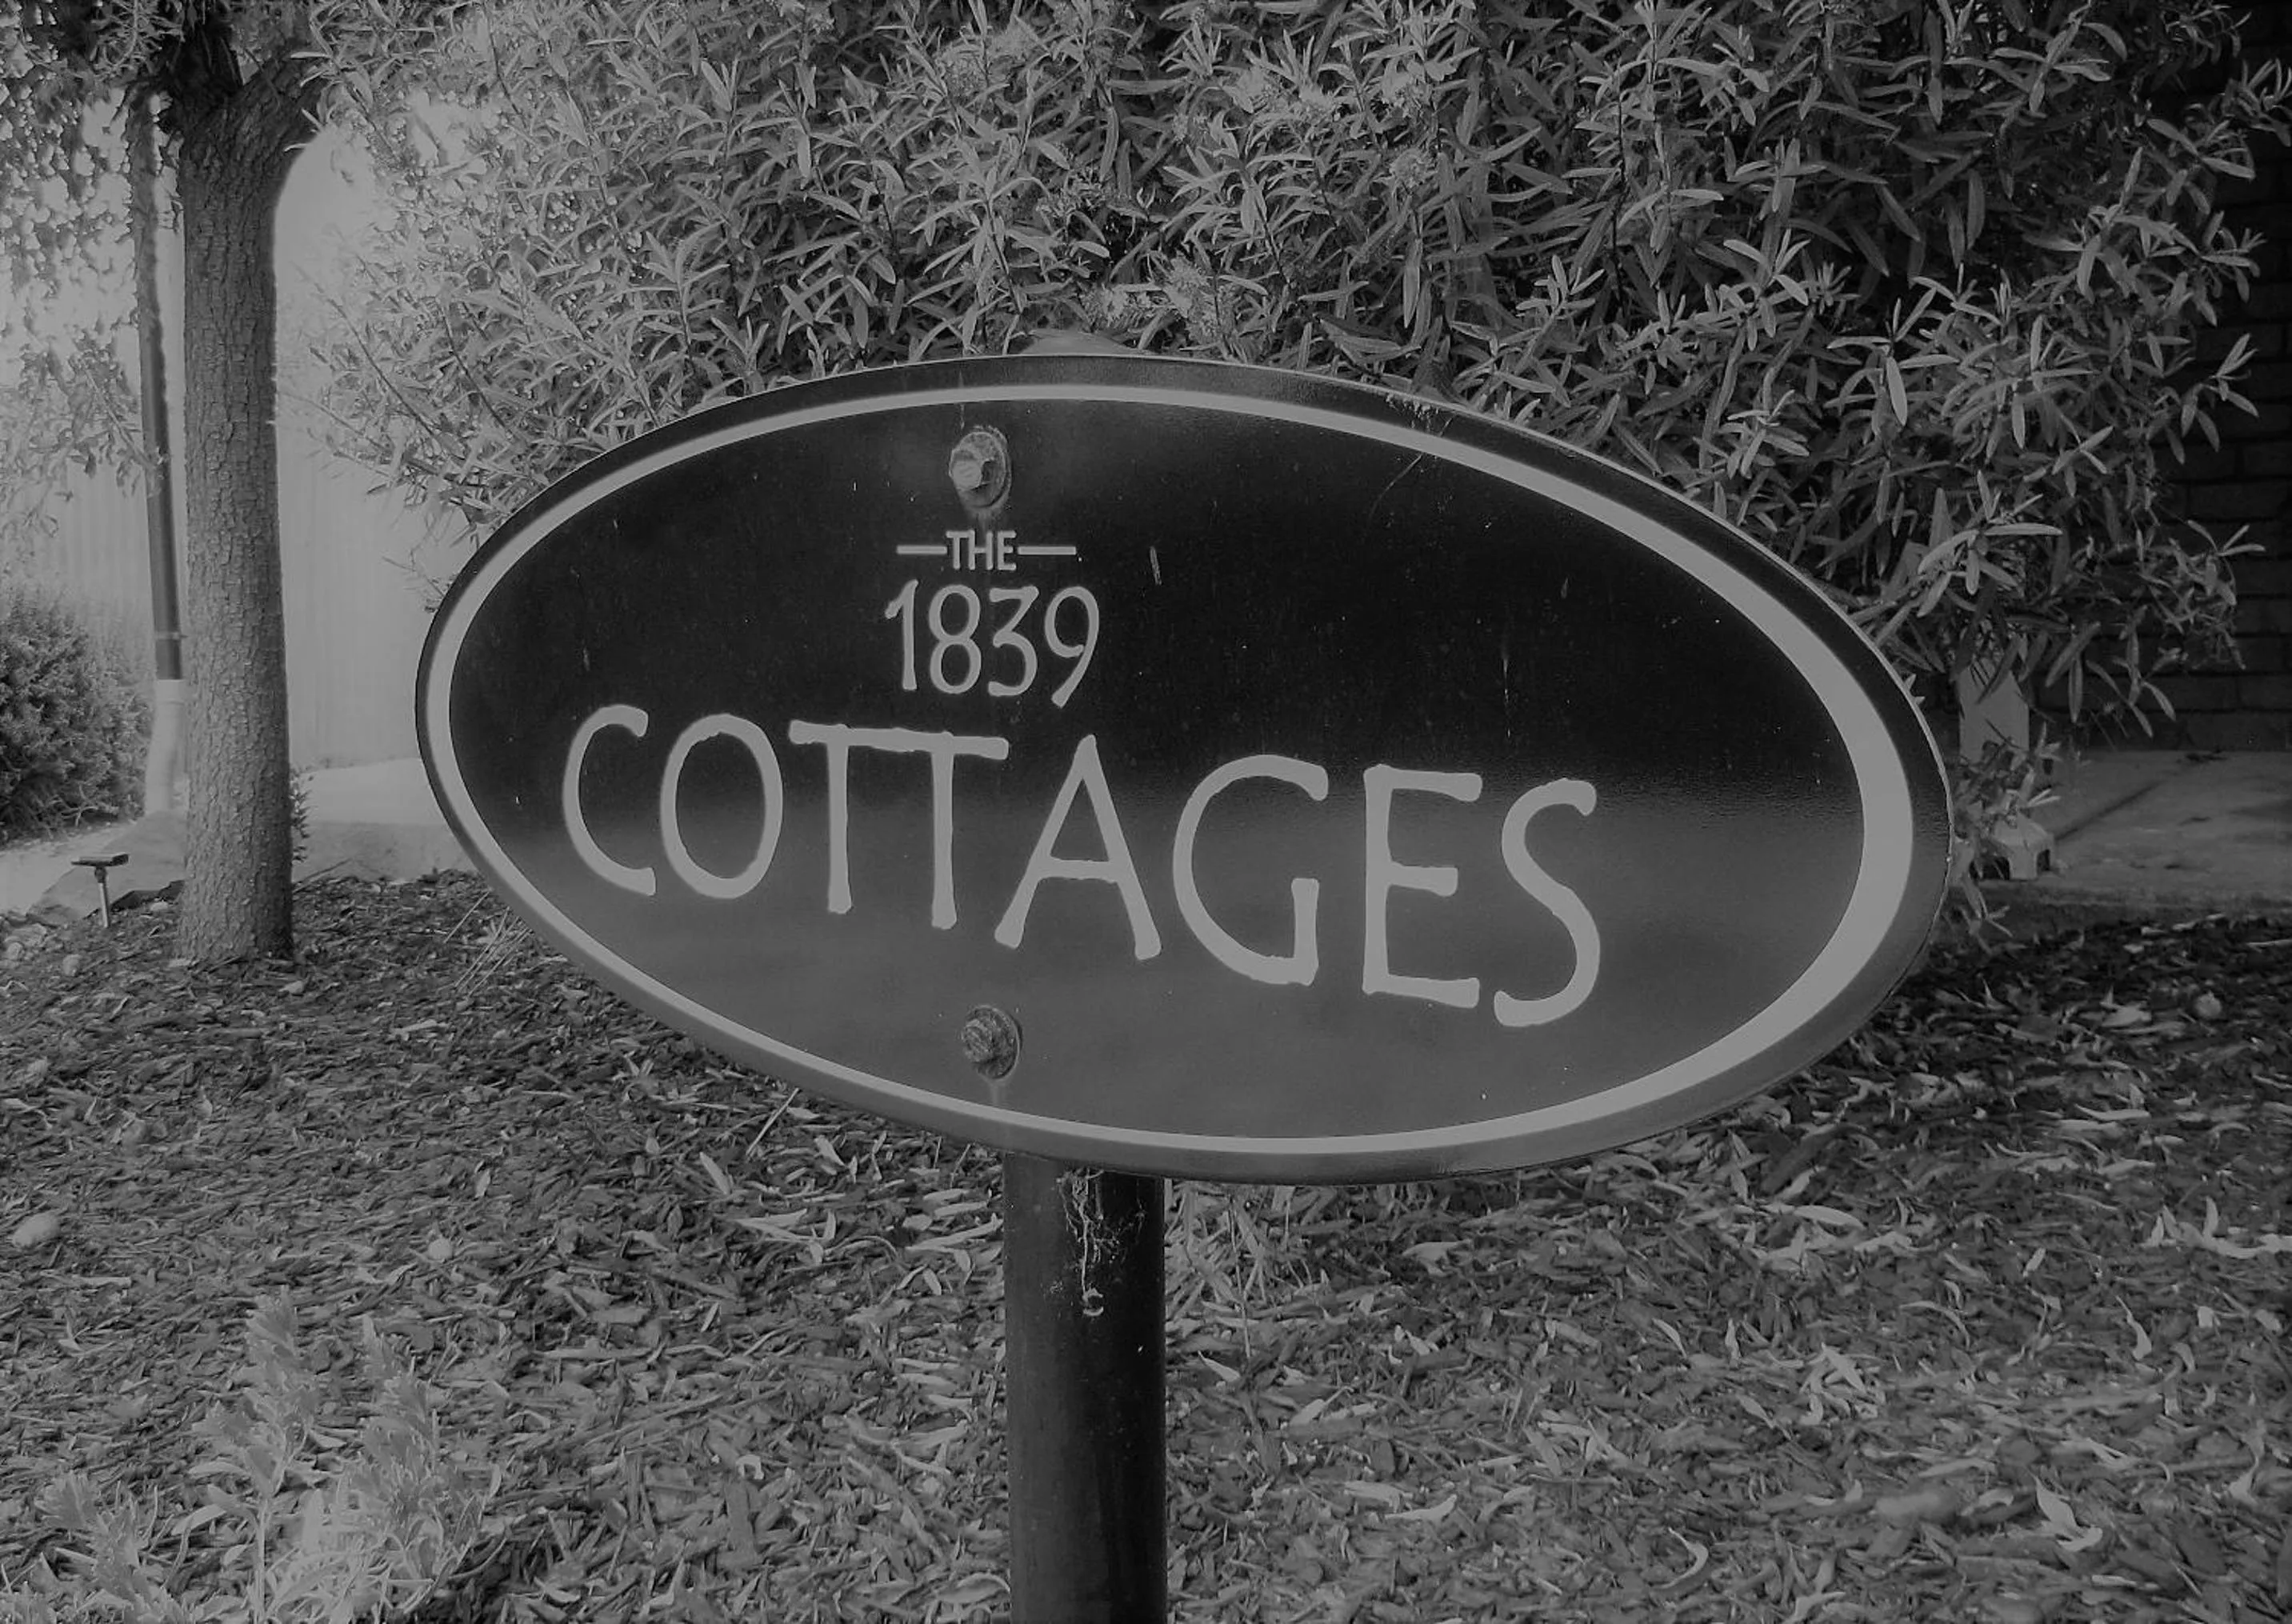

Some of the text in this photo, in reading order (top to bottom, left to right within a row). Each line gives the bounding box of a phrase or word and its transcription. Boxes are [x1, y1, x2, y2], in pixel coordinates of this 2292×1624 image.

[946, 529, 1018, 571] THE
[884, 578, 1100, 709] 1839
[562, 703, 1601, 1028] COTTAGES
